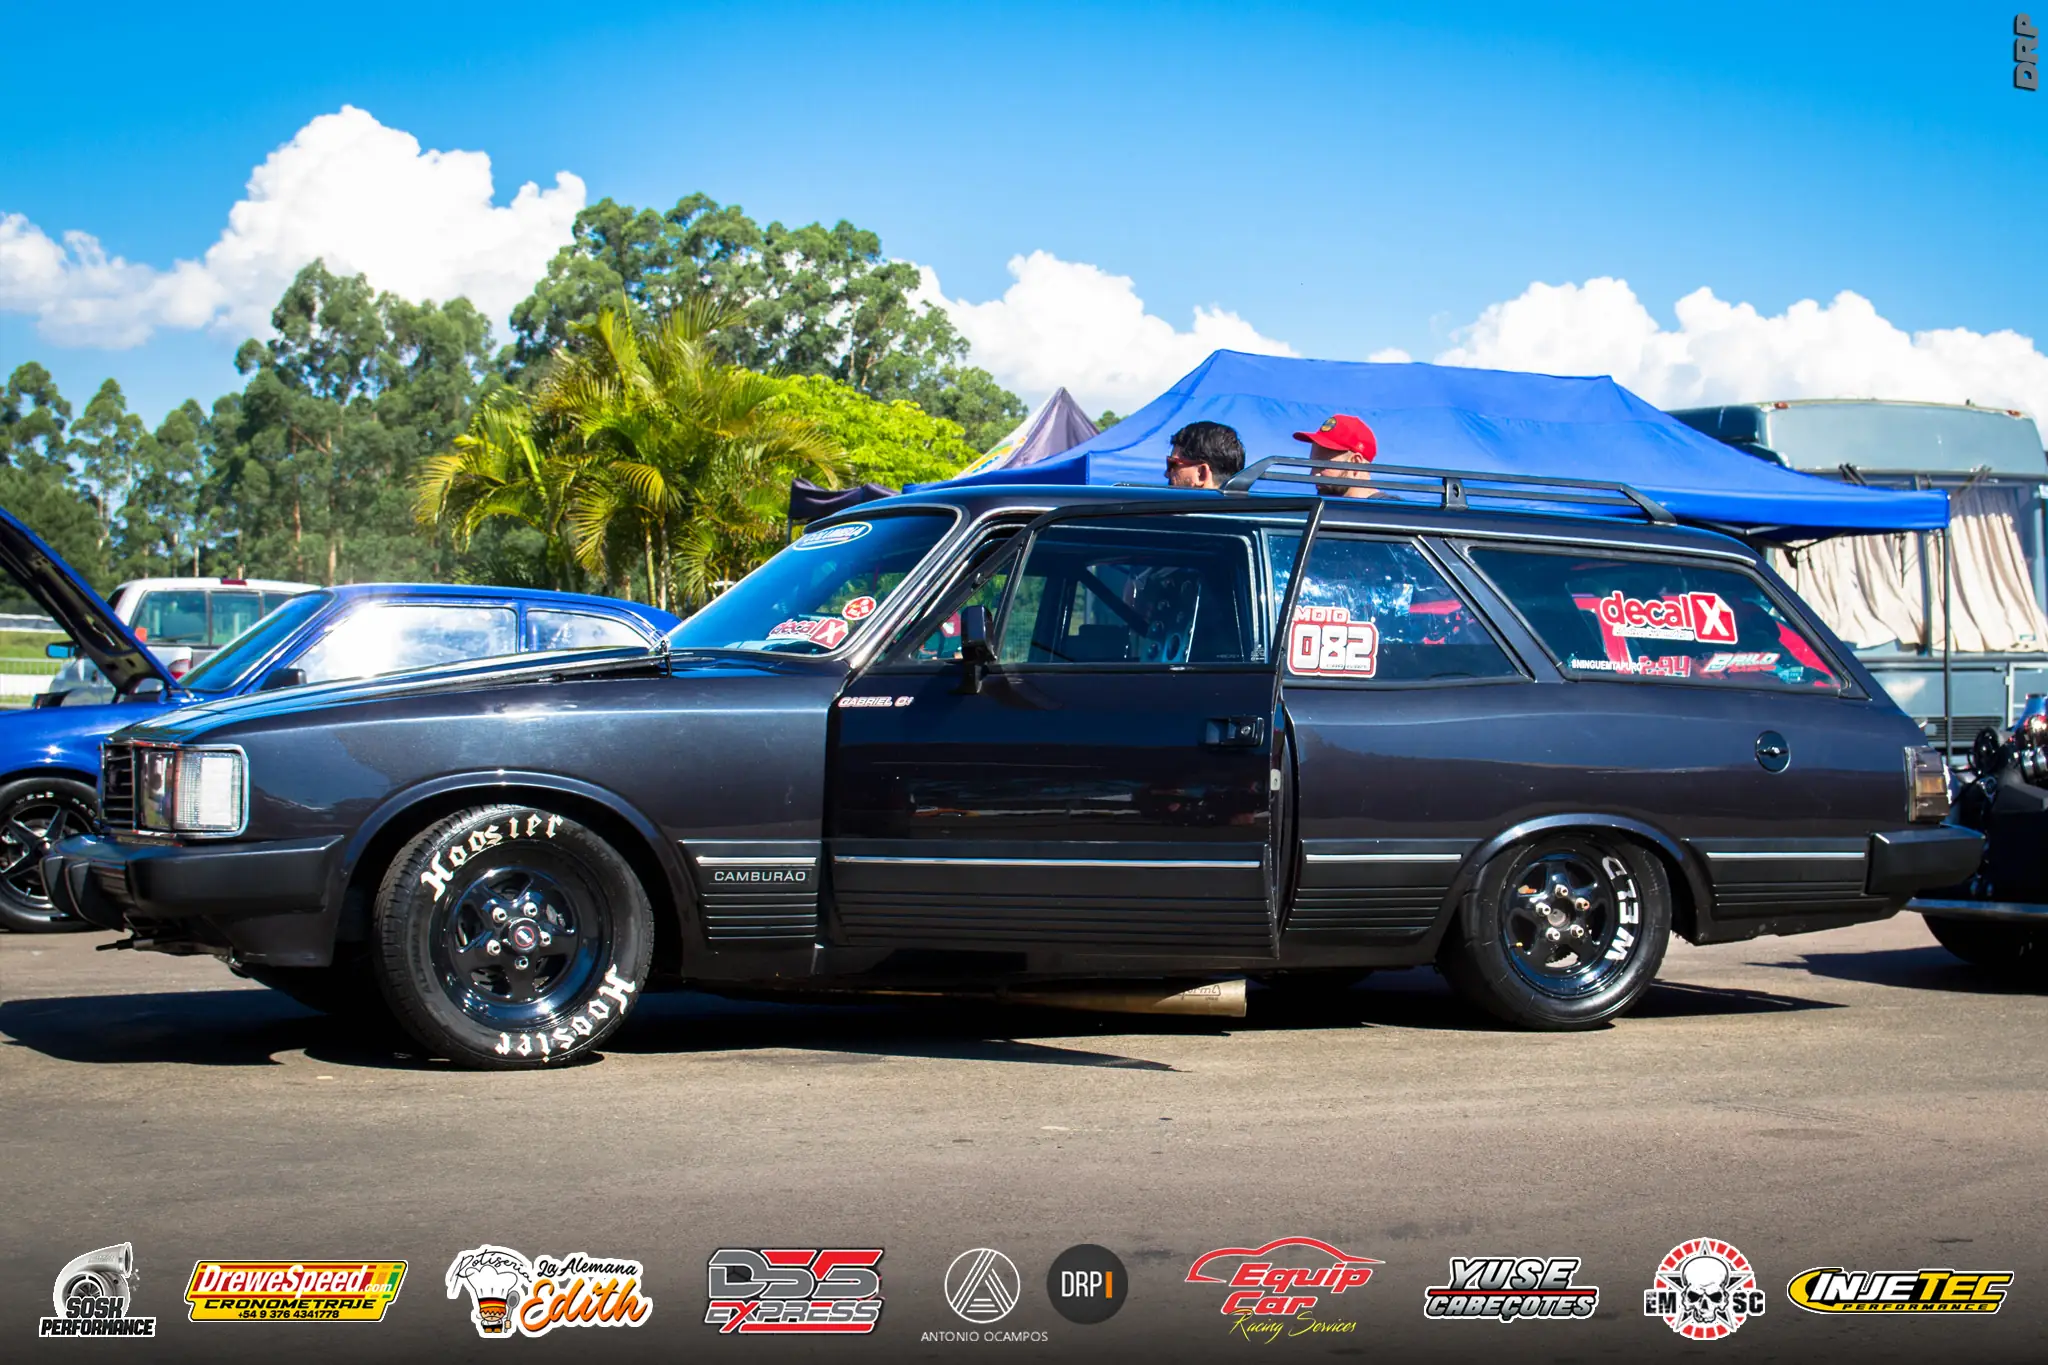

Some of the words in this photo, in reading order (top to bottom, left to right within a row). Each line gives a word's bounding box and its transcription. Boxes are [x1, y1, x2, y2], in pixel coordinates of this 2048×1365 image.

[1289, 622, 1377, 674] 082
[838, 696, 893, 707] GABRIEL
[420, 812, 564, 902] Hoosier
[714, 870, 806, 882] CAMBURÃO
[1602, 856, 1639, 961] WELD
[494, 964, 637, 1063] Hoosier
